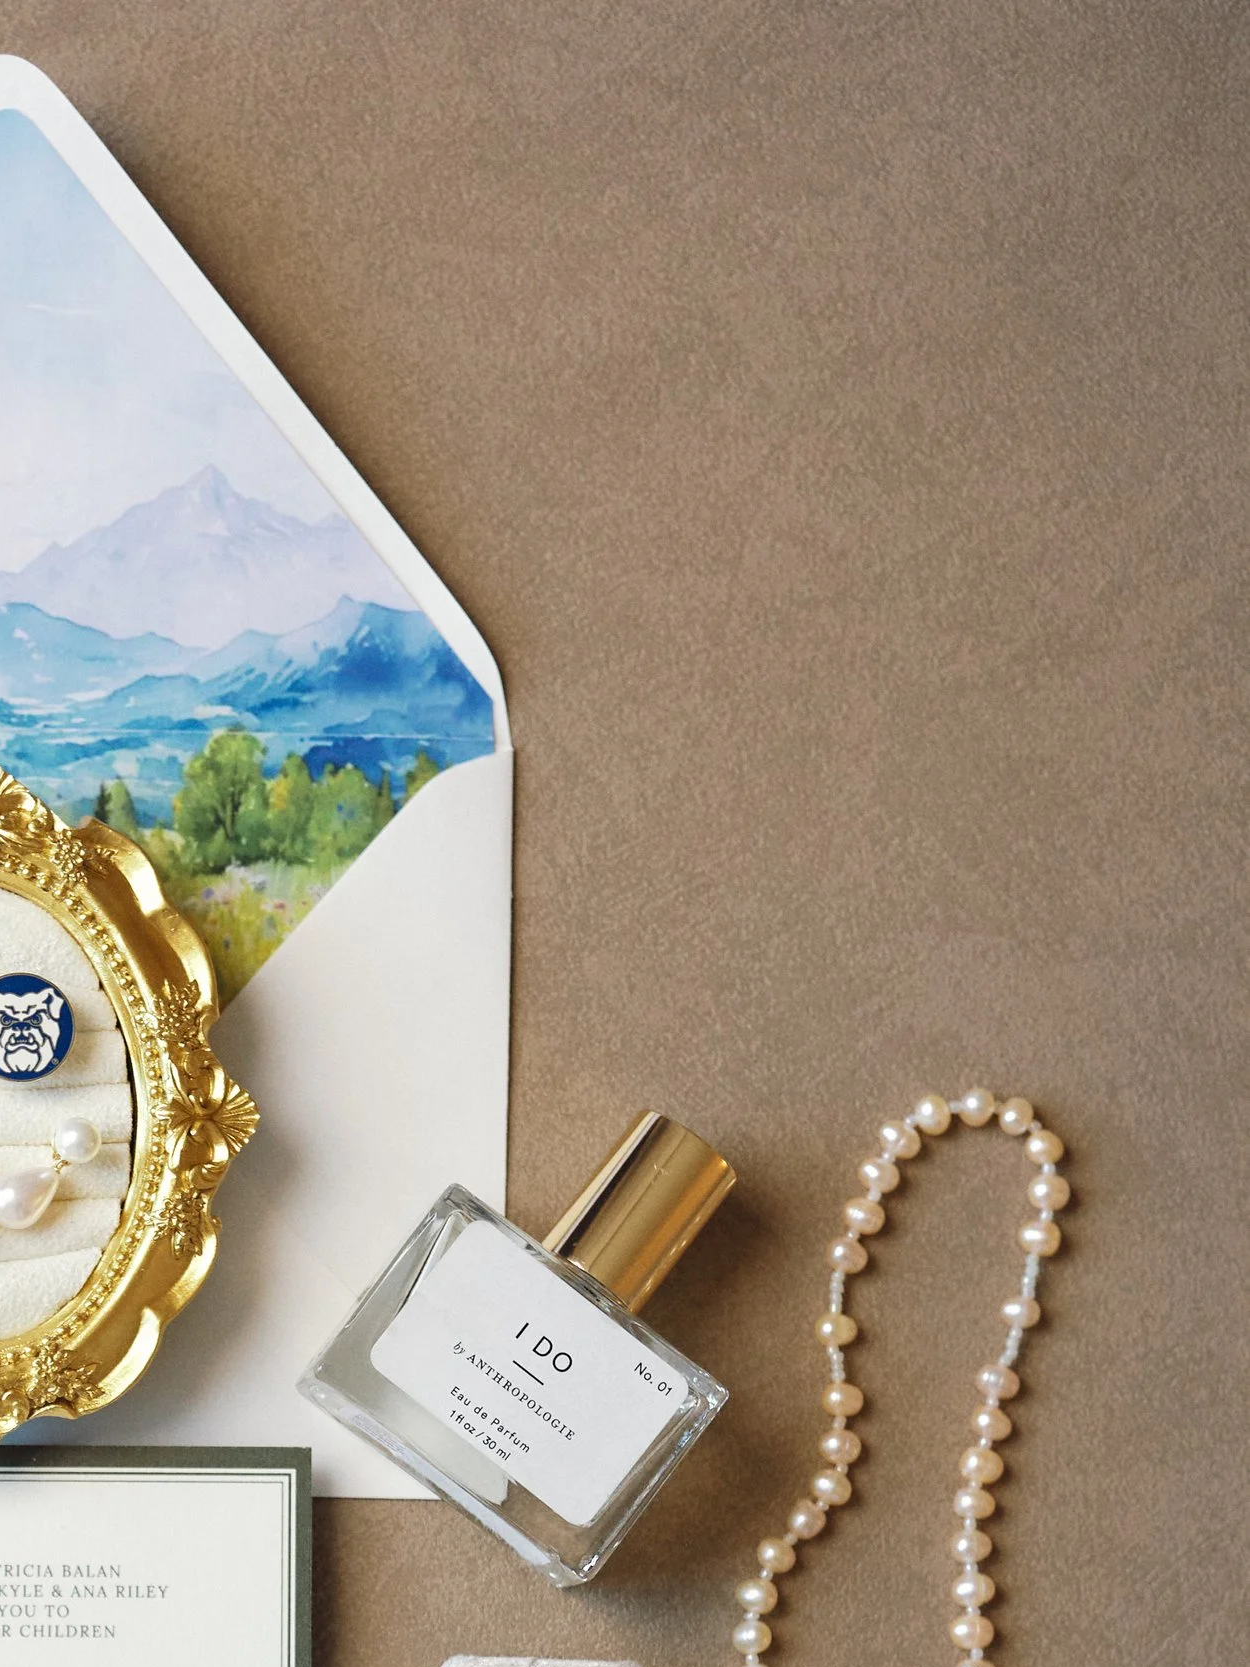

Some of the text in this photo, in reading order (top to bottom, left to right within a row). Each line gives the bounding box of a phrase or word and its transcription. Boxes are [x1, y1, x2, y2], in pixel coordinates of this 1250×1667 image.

[515, 1322, 573, 1373] I DO
[453, 1341, 576, 1441] by ANTHROPOLOGIE
[633, 1362, 673, 1397] No. 01
[450, 1386, 530, 1453] Eau de Parfum
[450, 1410, 456, 1418] 1
[455, 1414, 465, 1424] fl
[463, 1422, 476, 1435] oz
[482, 1435, 497, 1450] 30
[496, 1448, 511, 1461] ml
[62, 1564, 121, 1579] BALAN
[51, 1584, 63, 1598] &
[70, 1585, 108, 1598] ANA
[115, 1584, 168, 1599] RILEY
[44, 1604, 70, 1618] TO
[19, 1624, 116, 1639] CHILDREN
